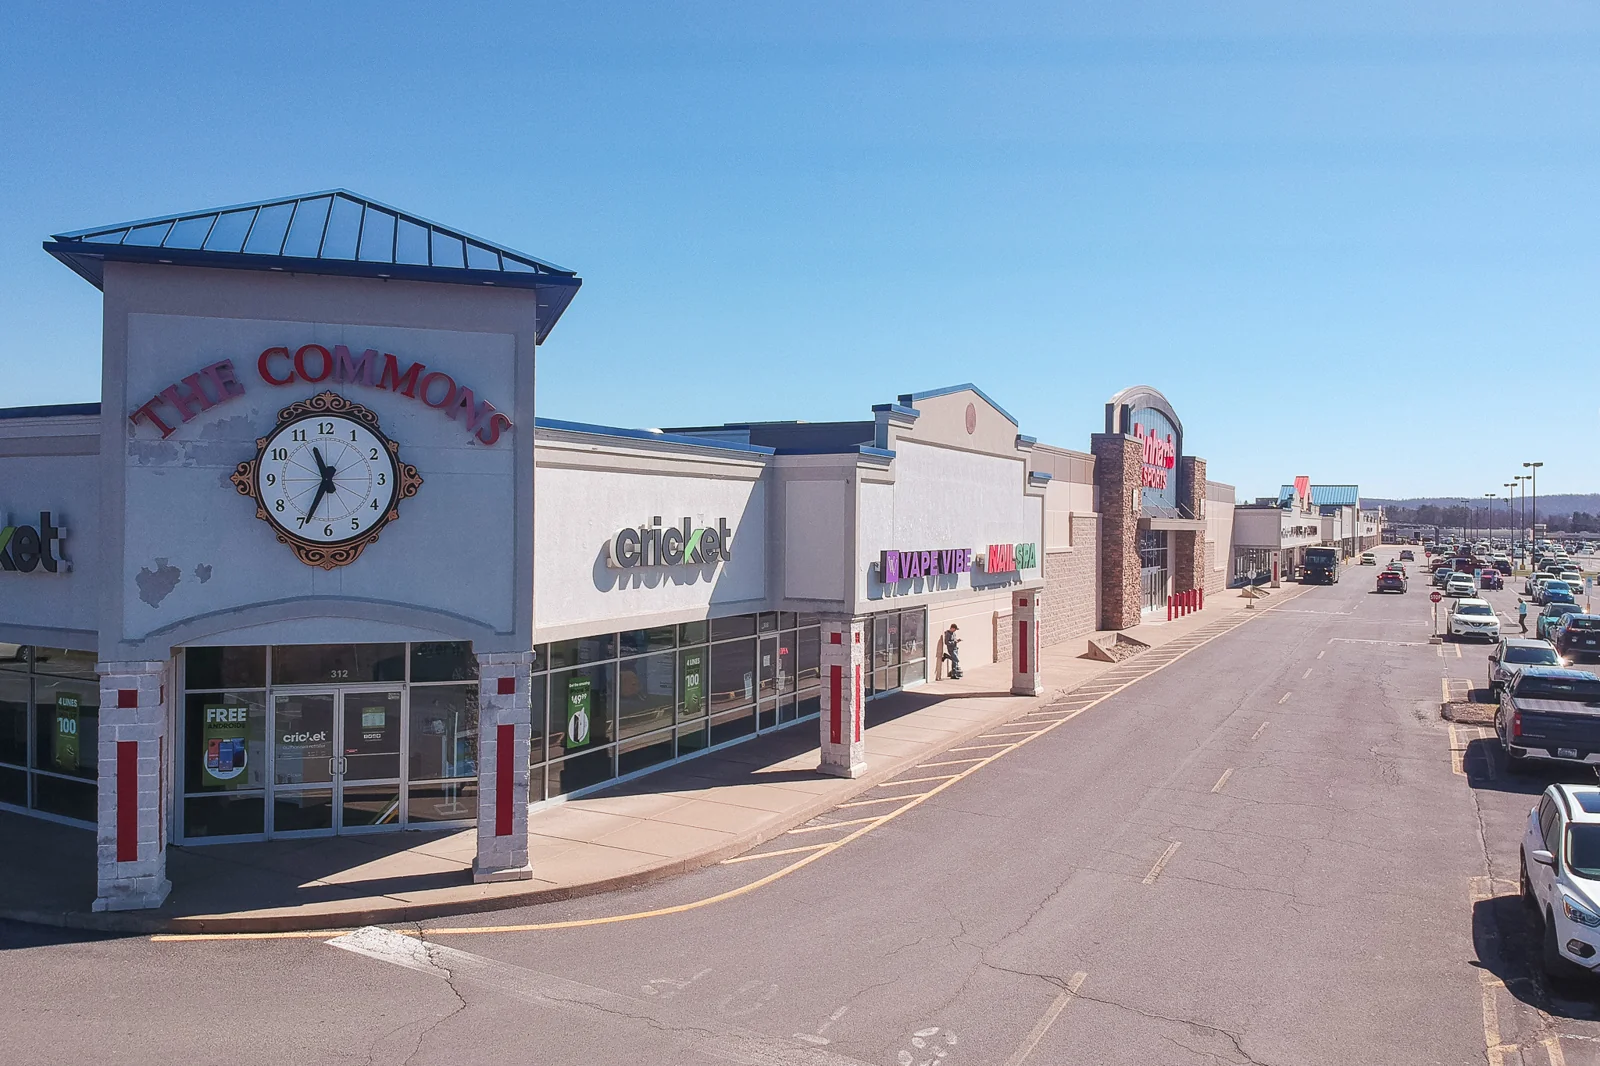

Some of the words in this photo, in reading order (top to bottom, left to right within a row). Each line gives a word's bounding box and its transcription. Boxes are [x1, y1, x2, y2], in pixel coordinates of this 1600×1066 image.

[128, 358, 245, 440] THE
[257, 343, 514, 446] COMMONS
[291, 429, 307, 441] 11
[317, 422, 334, 435] 12
[350, 430, 357, 441] 1
[271, 448, 288, 460] 10
[369, 447, 379, 460] 2
[266, 473, 276, 486] 9
[377, 473, 386, 486] 3
[1142, 466, 1167, 490] SPORTS
[275, 499, 285, 512] 8
[370, 498, 379, 510] 4
[296, 517, 306, 529] 7
[350, 517, 359, 530] 5
[323, 524, 333, 536] 6
[612, 515, 731, 568] cricket
[900, 550, 939, 579] VAPE
[941, 548, 971, 575] VIBE
[987, 543, 1016, 574] NAIL
[1015, 542, 1037, 571] SPA
[330, 669, 349, 678] 312
[58, 697, 62, 705] 4
[62, 697, 78, 708] LINES
[206, 707, 247, 723] FREE
[282, 731, 327, 743] cricket
